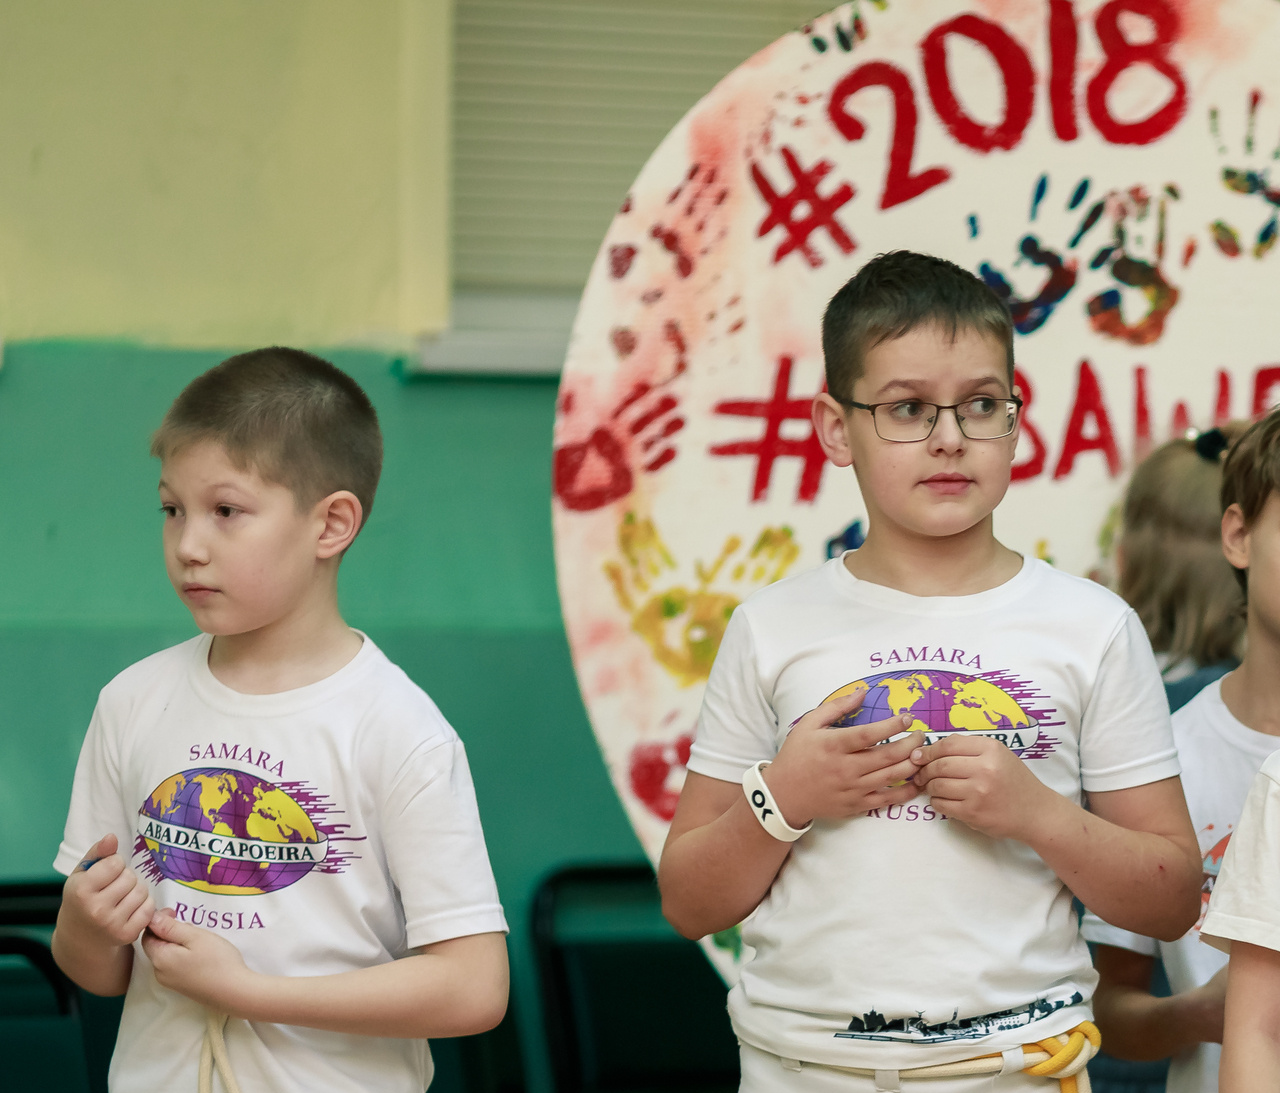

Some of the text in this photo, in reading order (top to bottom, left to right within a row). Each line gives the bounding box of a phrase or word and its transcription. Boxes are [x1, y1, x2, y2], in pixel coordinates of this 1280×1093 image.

[870, 645, 983, 670] SAMARA
[189, 742, 285, 778] SAMARA
[143, 820, 316, 862] ABADÁ-CAPOEIRA
[174, 902, 266, 931] RÚSSIA
